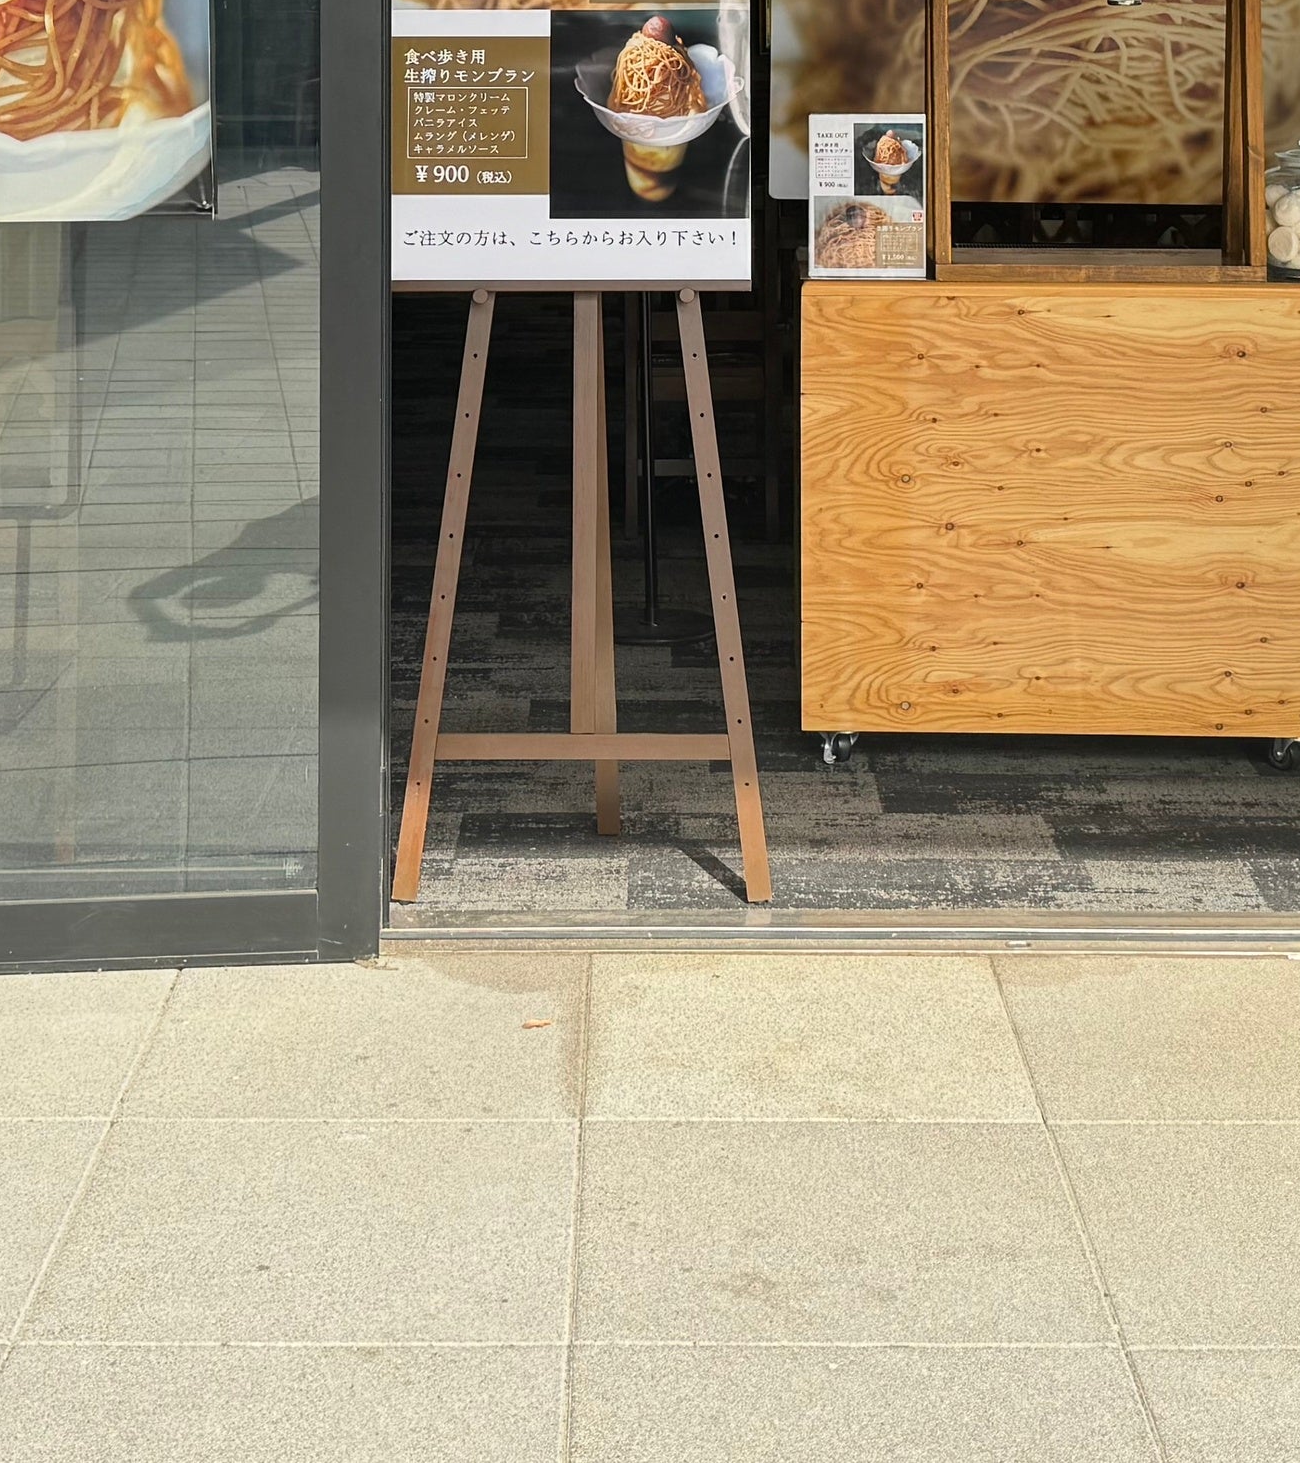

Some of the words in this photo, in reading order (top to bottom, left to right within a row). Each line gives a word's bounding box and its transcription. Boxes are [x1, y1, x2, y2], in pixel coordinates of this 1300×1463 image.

[404, 48, 485, 65] 食べ歩き用
[404, 67, 535, 84] 生搾りモンブラン
